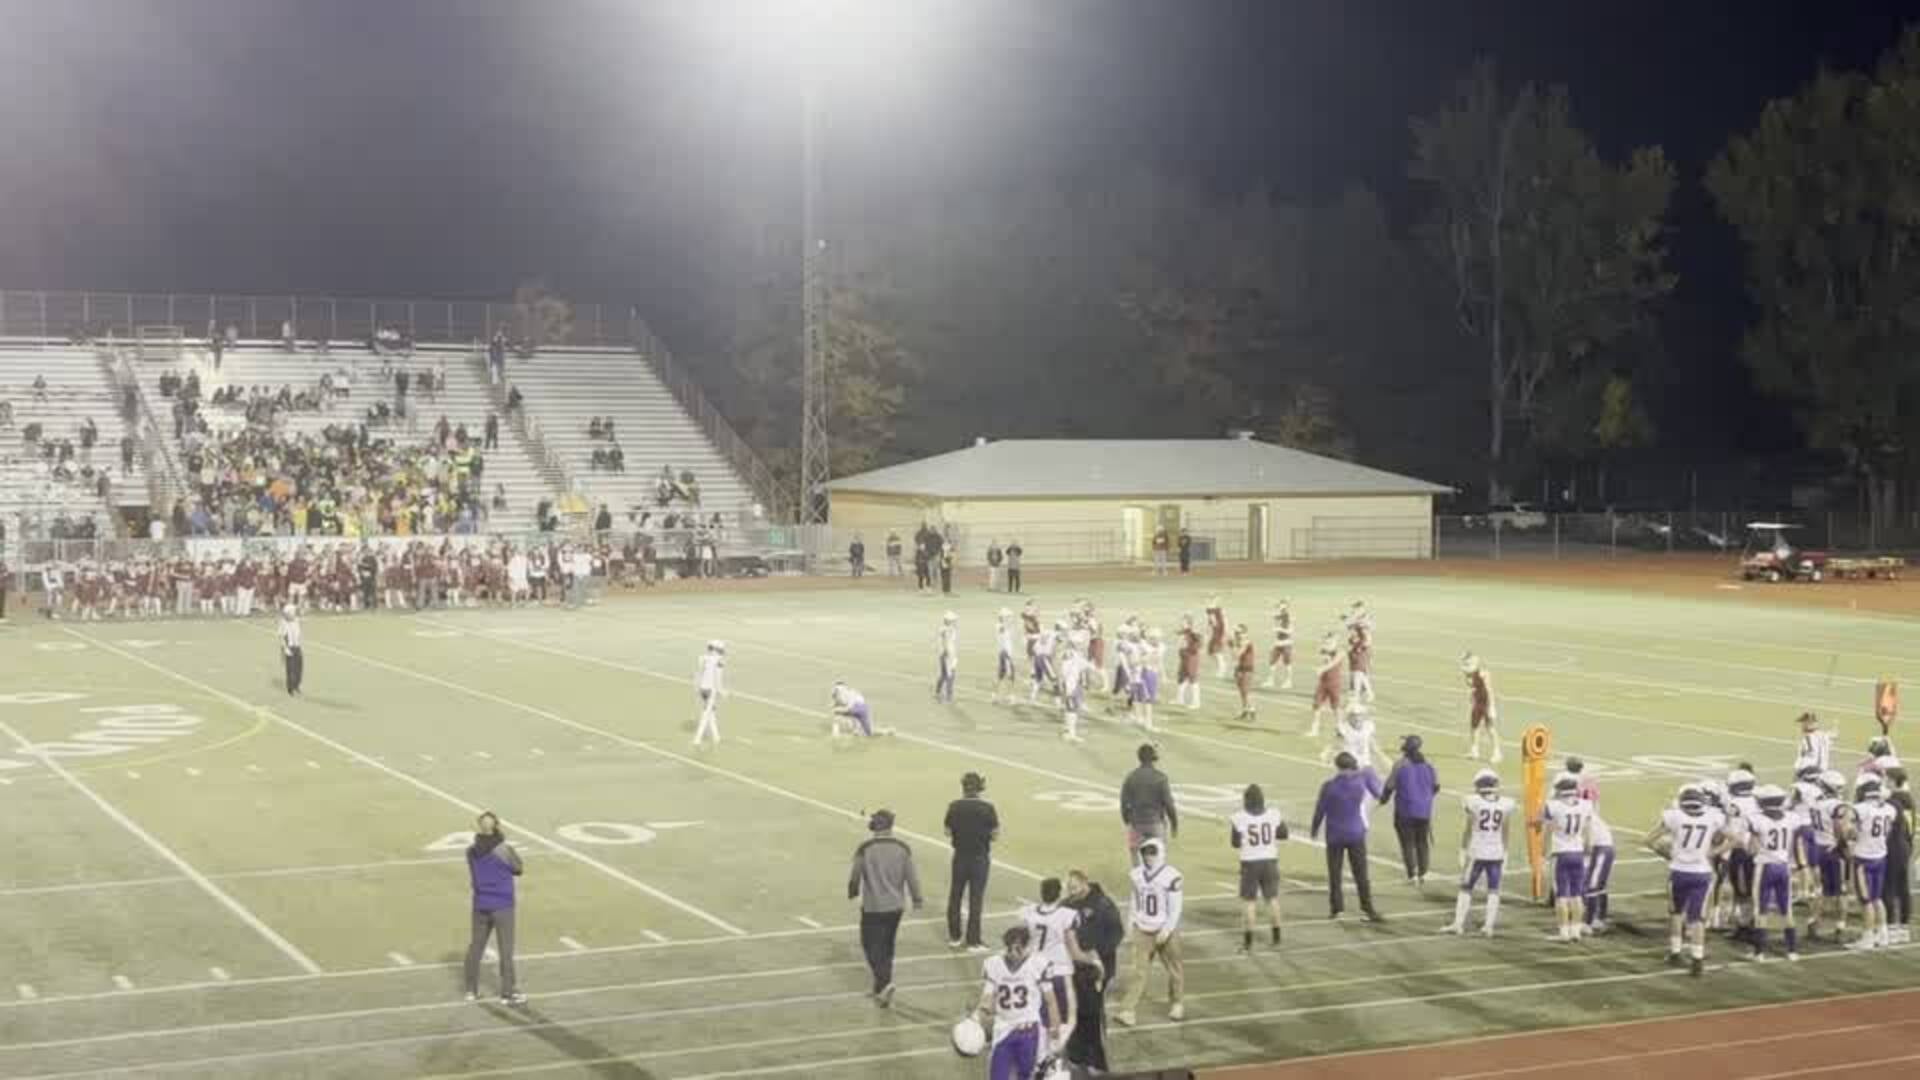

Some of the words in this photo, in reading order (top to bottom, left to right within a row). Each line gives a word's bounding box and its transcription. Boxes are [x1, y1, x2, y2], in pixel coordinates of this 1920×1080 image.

[1479, 809, 1503, 831] 29
[1247, 823, 1272, 847] 50
[1681, 824, 1708, 849] 77
[1767, 827, 1788, 851] 31
[998, 984, 1028, 1010] 23
